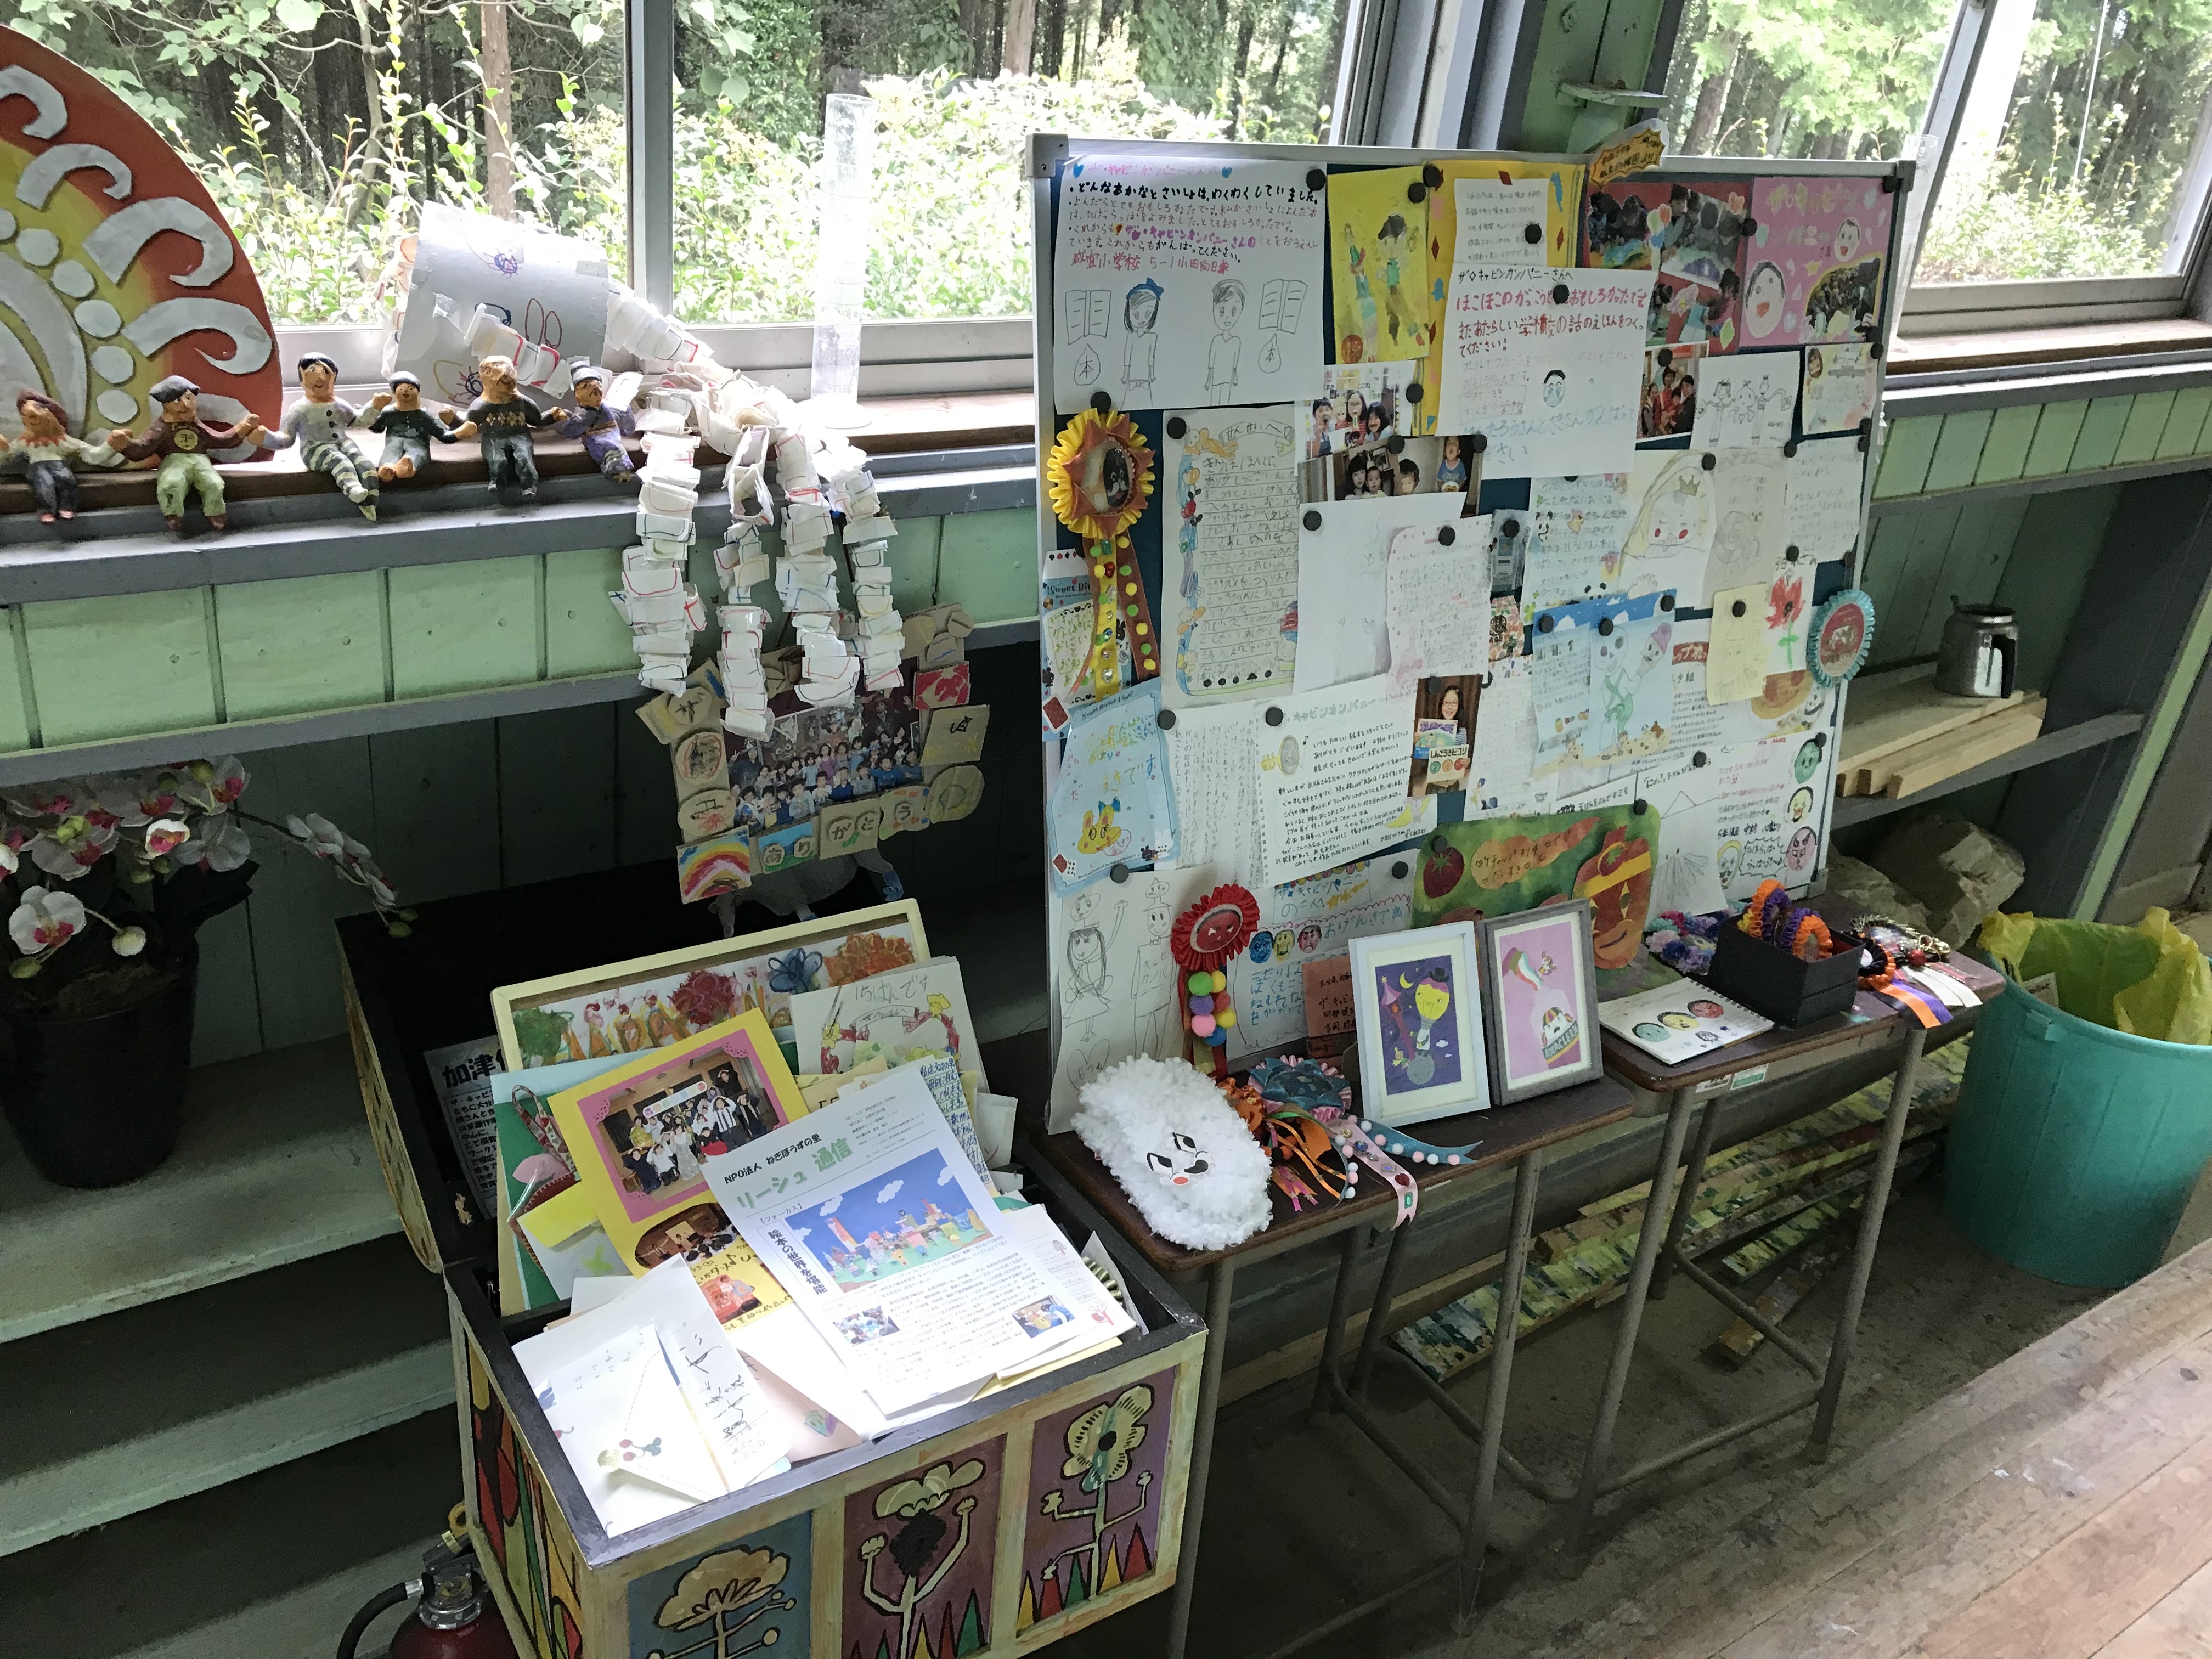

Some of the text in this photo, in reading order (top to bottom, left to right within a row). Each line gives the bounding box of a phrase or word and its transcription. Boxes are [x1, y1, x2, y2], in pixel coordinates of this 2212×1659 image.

[1079, 355, 1096, 380] 本
[724, 1162, 763, 1185] NPO法人
[736, 1137, 855, 1209] リーシュ 通信
[768, 1229, 828, 1295] 絵本の世界を堪能
